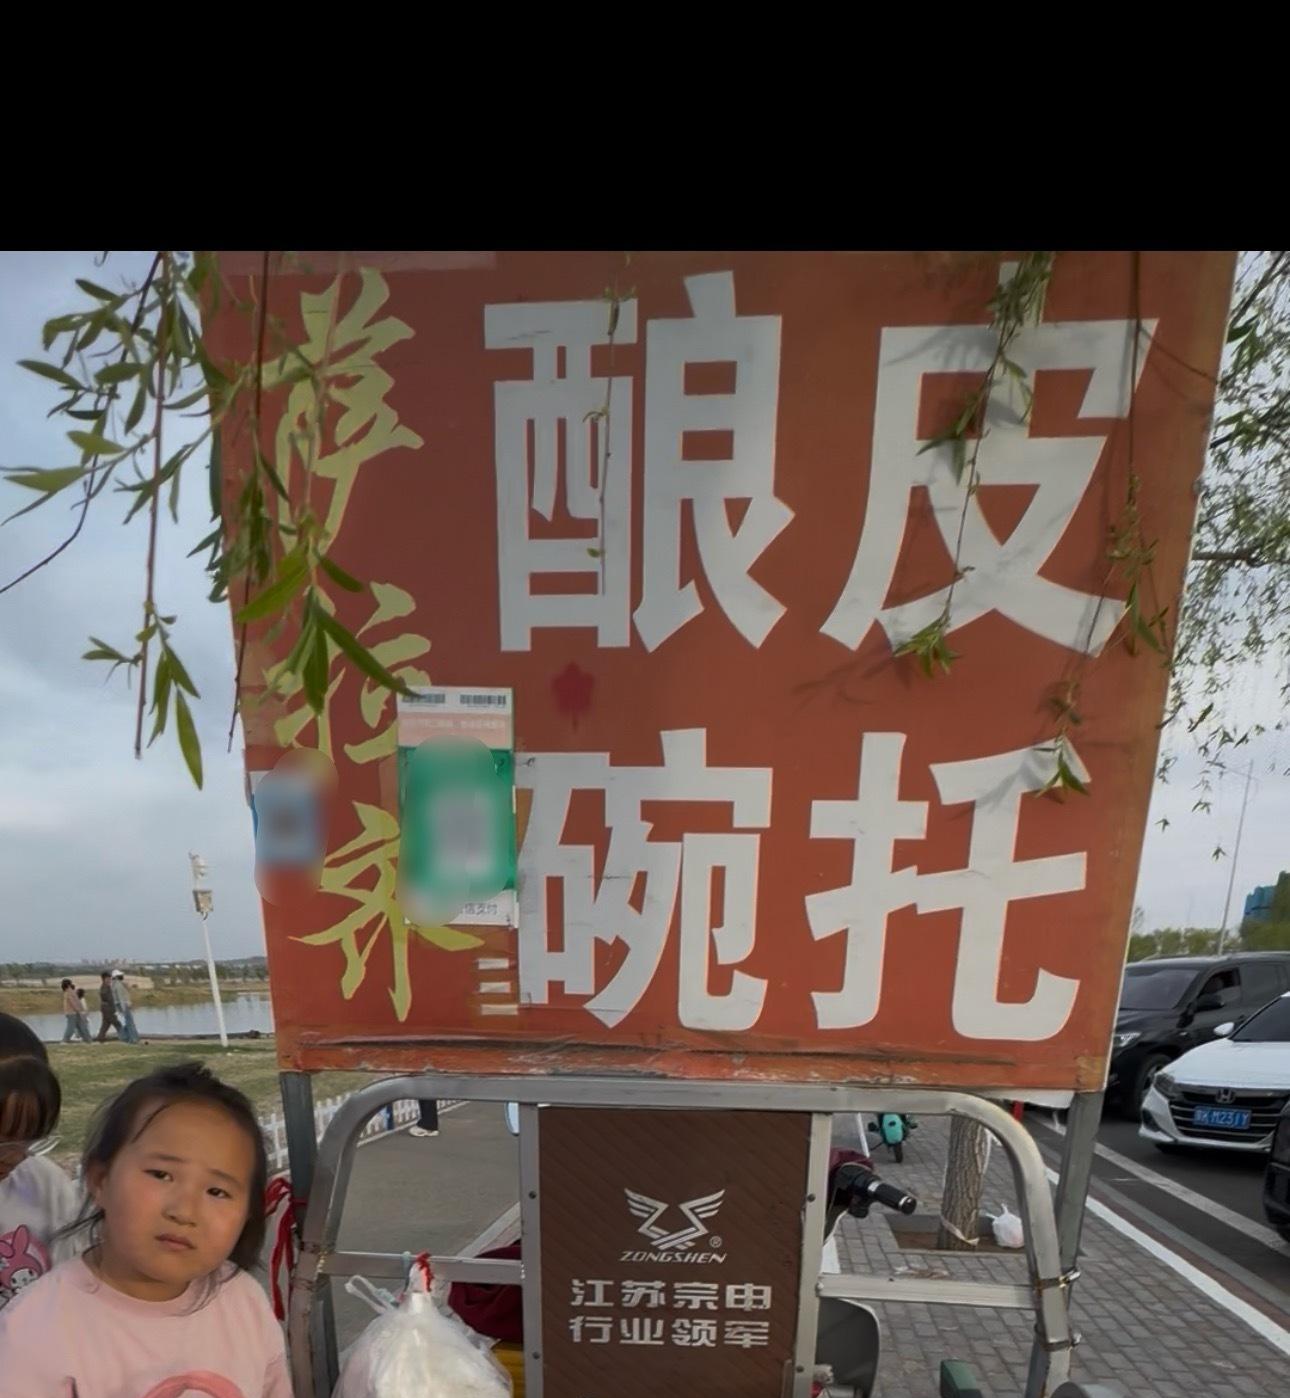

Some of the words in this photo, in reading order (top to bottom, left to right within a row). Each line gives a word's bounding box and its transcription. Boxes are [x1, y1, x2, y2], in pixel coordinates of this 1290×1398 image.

[485, 262, 1159, 659] 酿皮
[514, 728, 1092, 1041] 碗托
[619, 1250, 728, 1264] ZONGSHEN
[570, 1278, 772, 1312] 江苏宗申
[568, 1315, 770, 1349] 行业领军
